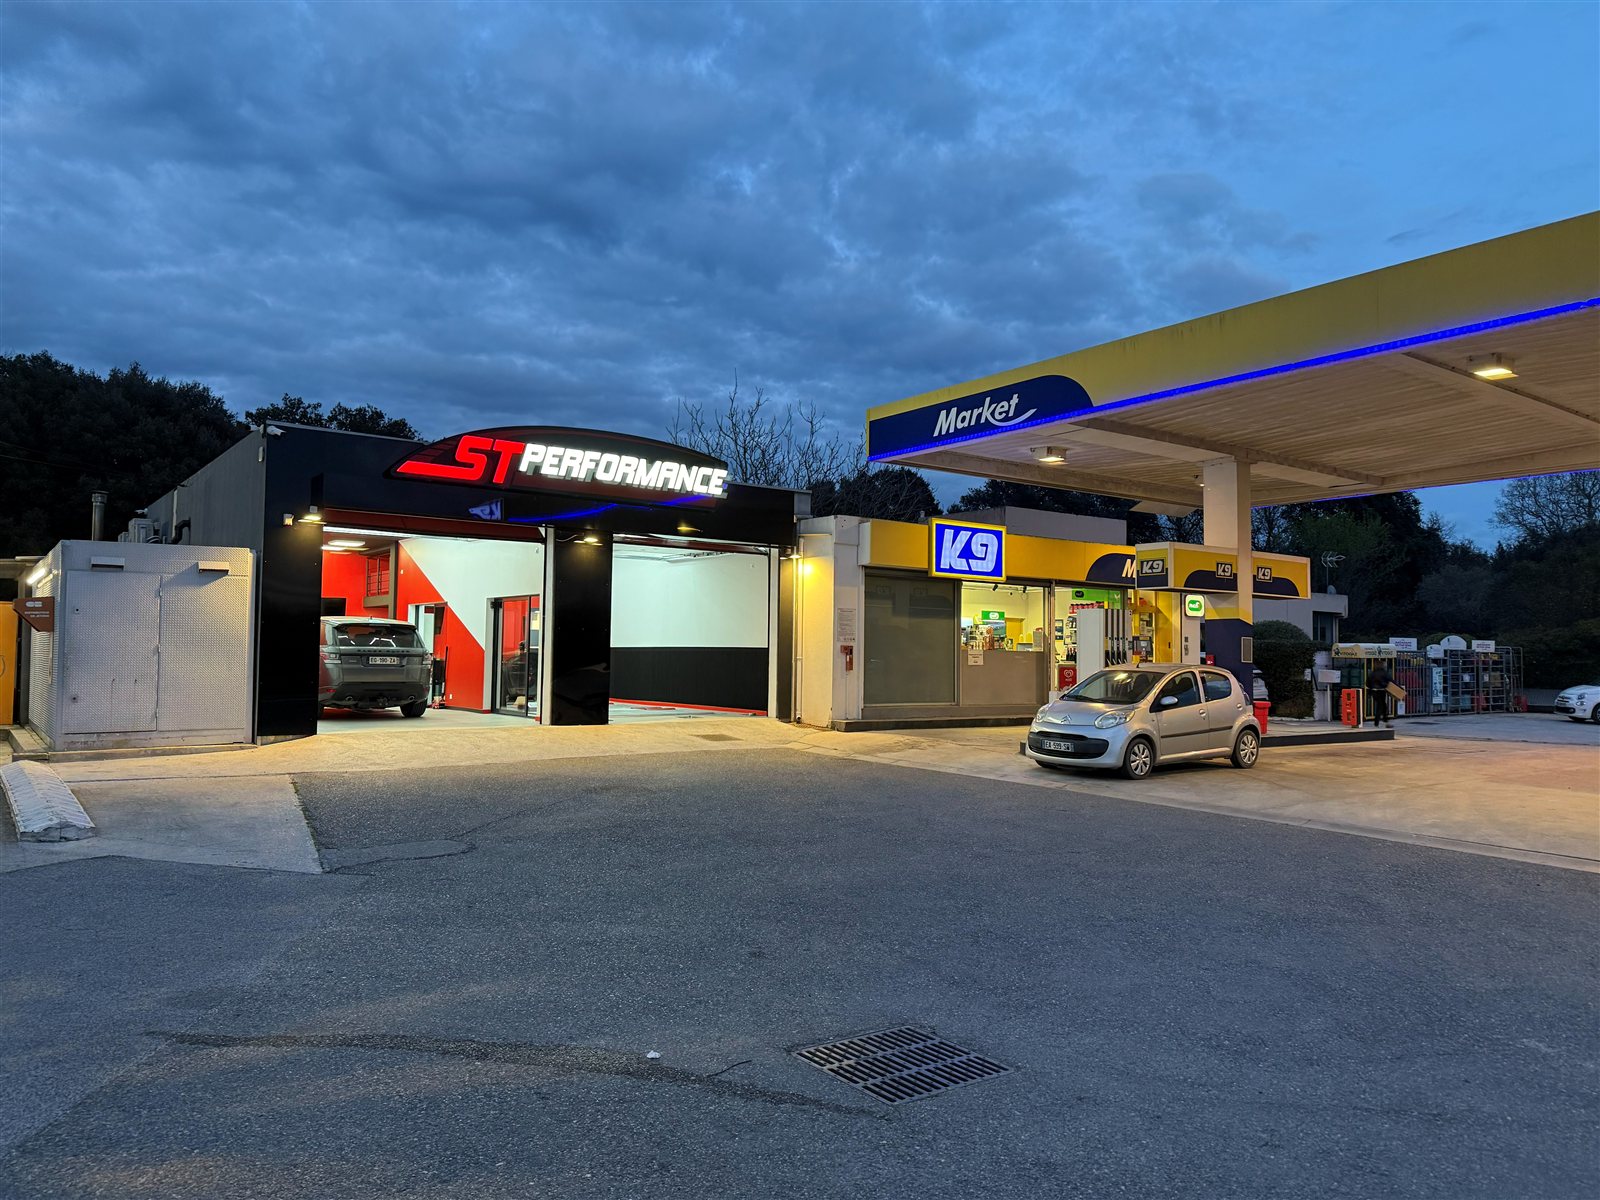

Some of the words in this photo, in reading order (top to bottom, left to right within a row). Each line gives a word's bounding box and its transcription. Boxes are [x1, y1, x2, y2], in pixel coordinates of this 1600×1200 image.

[933, 393, 1037, 437] Market
[396, 435, 525, 484] ST
[518, 442, 727, 495] PERFORMANCE
[940, 528, 999, 573] K9
[1142, 560, 1163, 574] K9
[1217, 563, 1232, 577] K9
[1258, 567, 1271, 580] K9
